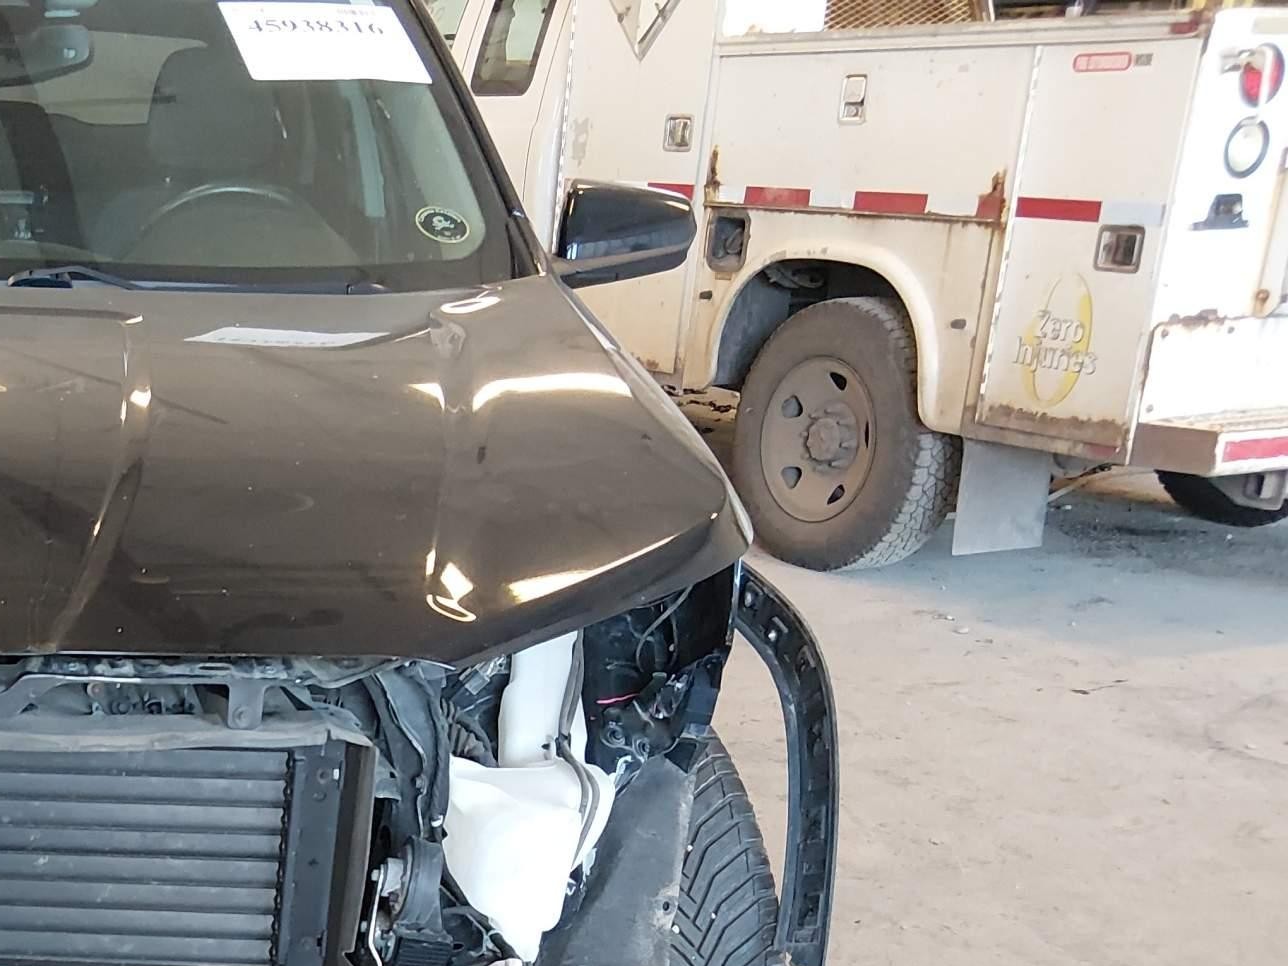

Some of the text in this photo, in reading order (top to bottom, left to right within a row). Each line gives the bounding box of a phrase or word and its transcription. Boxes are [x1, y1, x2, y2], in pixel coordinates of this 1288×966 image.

[248, 18, 385, 35] 45938316
[1037, 309, 1086, 344] Zero
[1011, 335, 1098, 375] Injuries
